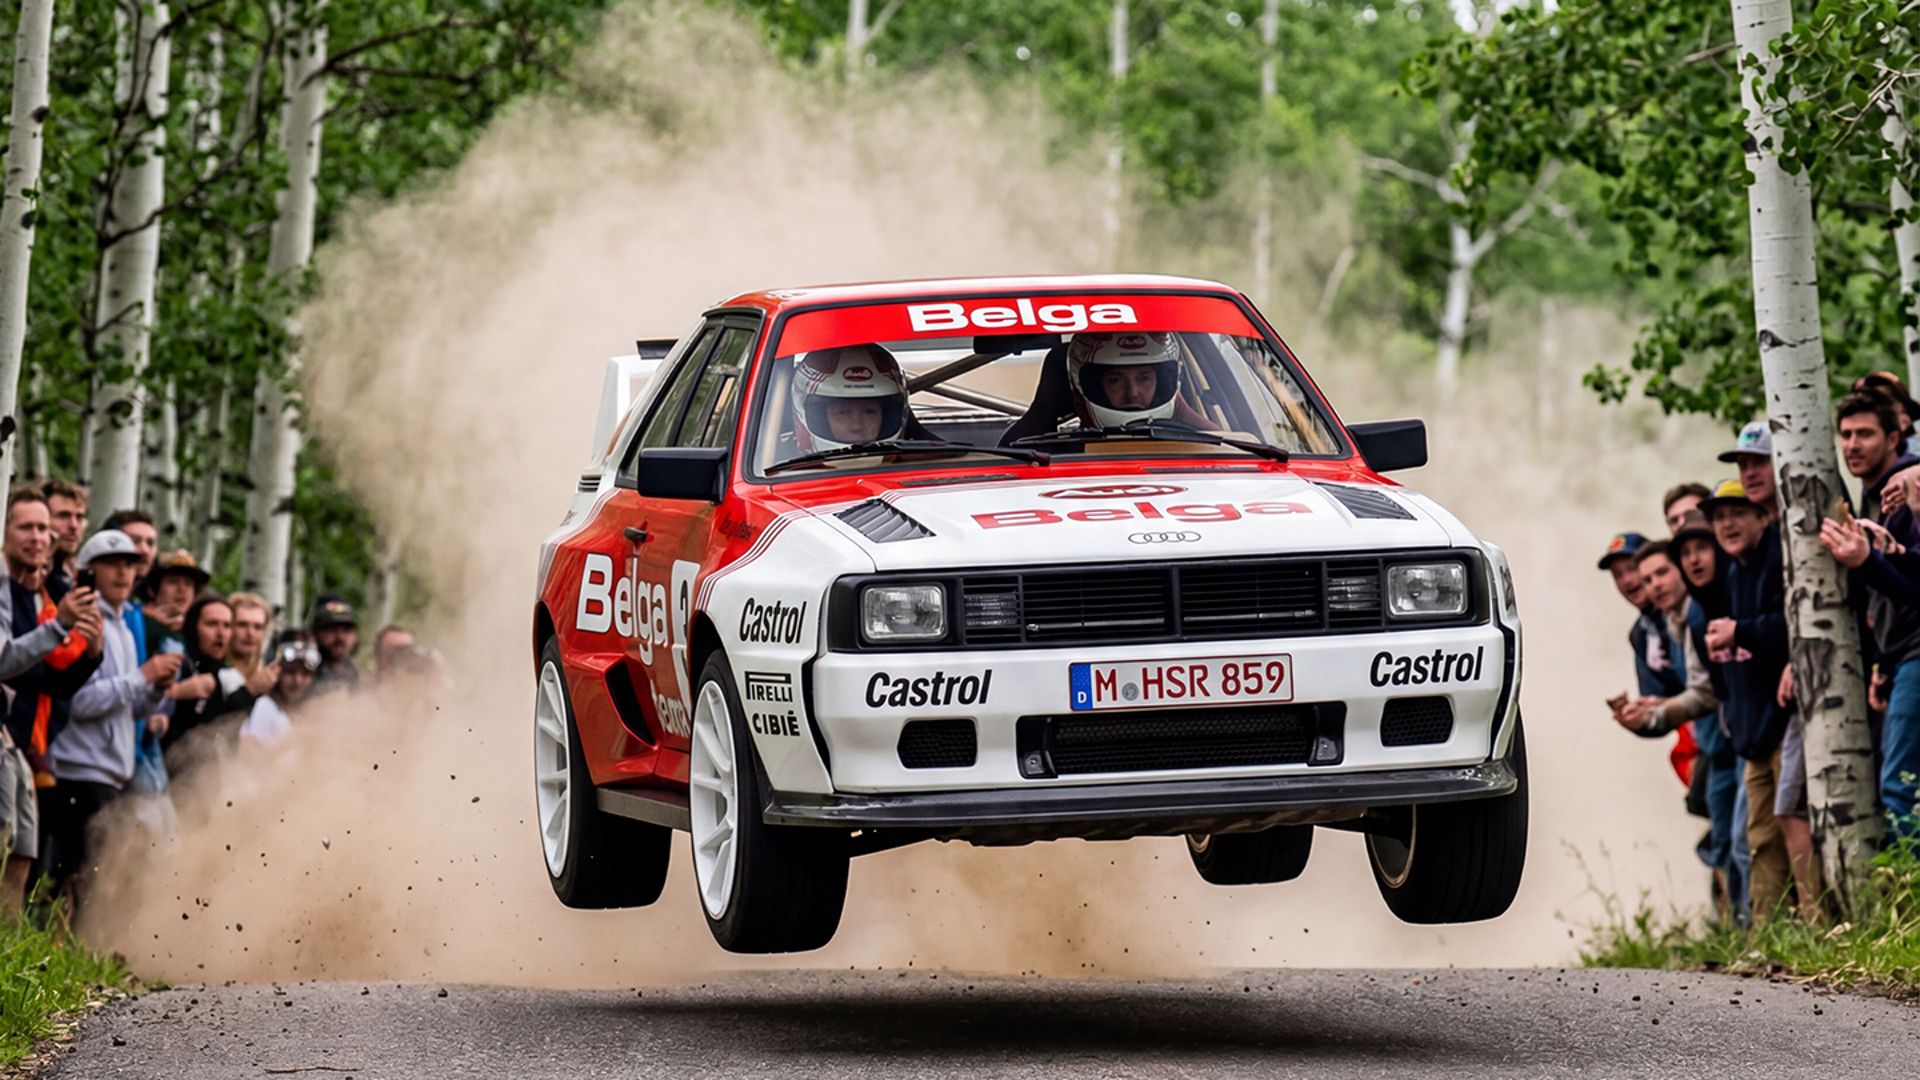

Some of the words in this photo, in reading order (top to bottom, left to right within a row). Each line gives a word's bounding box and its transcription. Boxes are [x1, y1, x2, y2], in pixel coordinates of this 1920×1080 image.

[907, 298, 1138, 332] Belga
[970, 502, 1313, 529] Belga
[576, 553, 668, 666] Belga
[740, 597, 807, 644] Castrol
[1095, 668, 1118, 702] M
[1142, 665, 1211, 700] HSR
[1221, 661, 1285, 696] 859
[1370, 646, 1484, 687] Castrol
[744, 671, 793, 702] PIRELLI
[865, 669, 992, 708] Castrol
[1077, 691, 1088, 703] D
[752, 710, 800, 736] CIBIÉ
